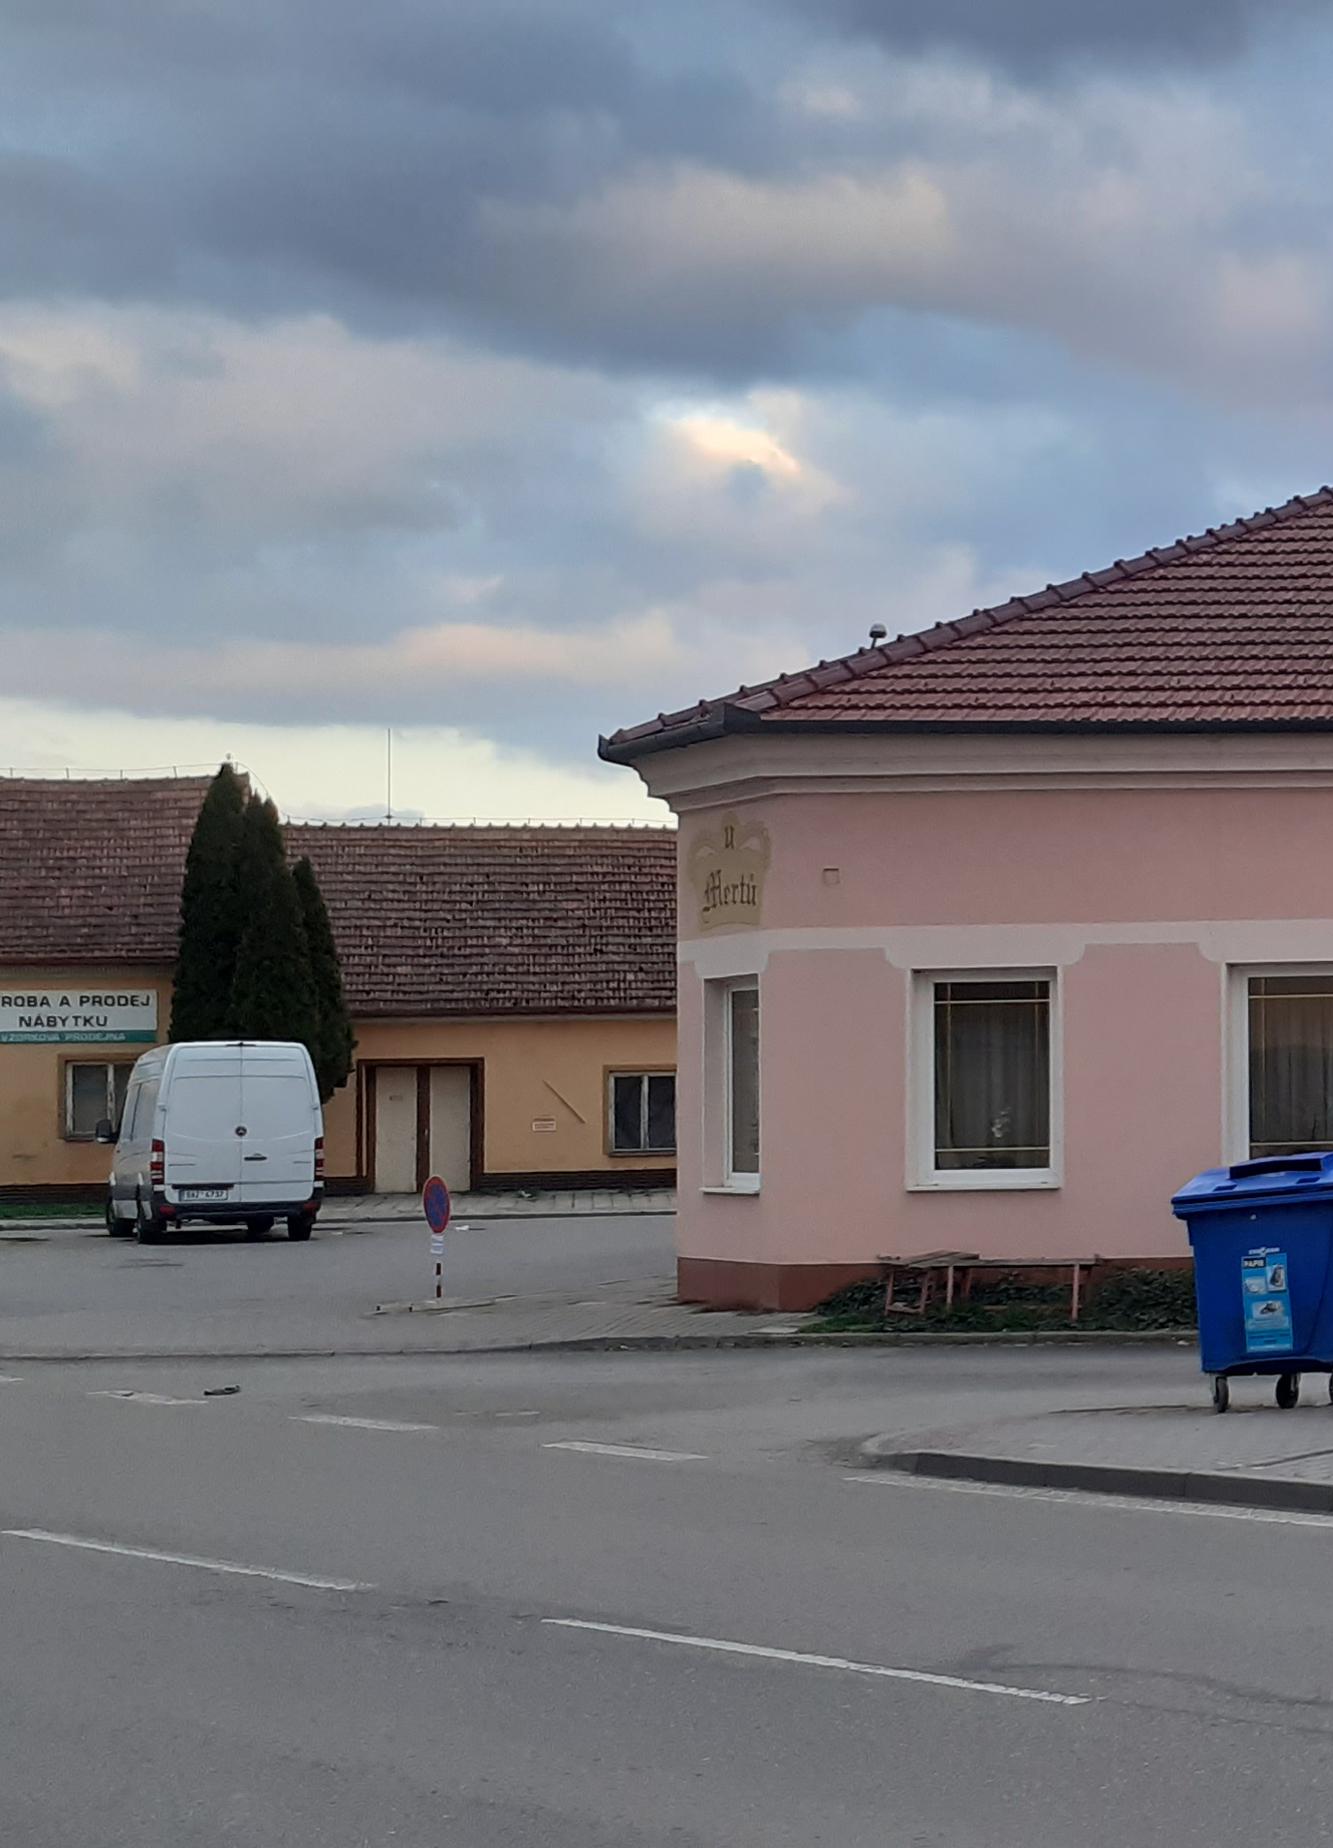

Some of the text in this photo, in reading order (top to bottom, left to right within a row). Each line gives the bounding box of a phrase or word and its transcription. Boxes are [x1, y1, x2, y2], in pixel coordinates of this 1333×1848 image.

[1, 995, 150, 1007] ROBA A PRODEJ
[19, 1014, 108, 1027] NÁBYTKU
[64, 1032, 126, 1042] PRODEJNA
